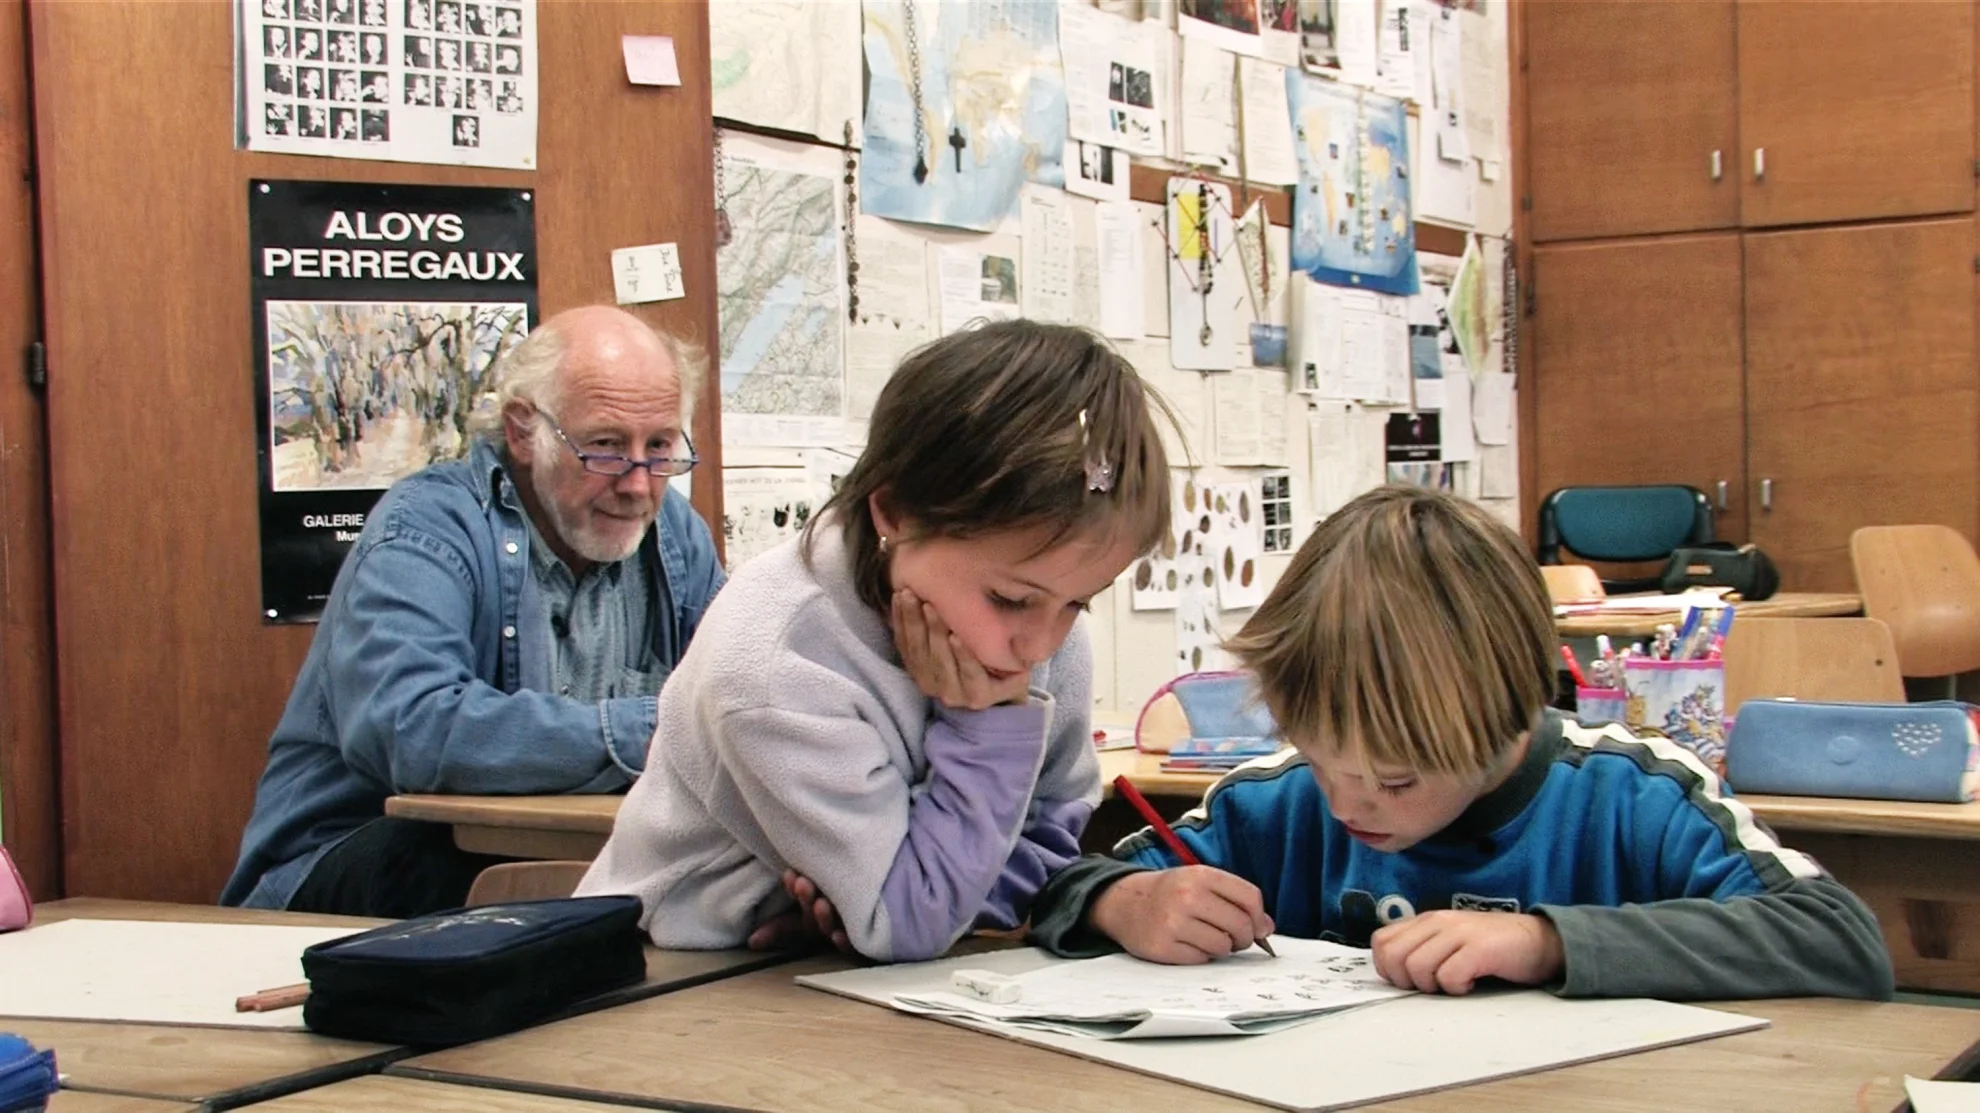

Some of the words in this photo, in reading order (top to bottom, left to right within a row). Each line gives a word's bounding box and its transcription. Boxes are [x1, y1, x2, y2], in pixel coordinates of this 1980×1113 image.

[325, 211, 464, 242] ALOYS
[263, 248, 525, 281] PERREGAUX
[303, 515, 364, 528] GALERIE
